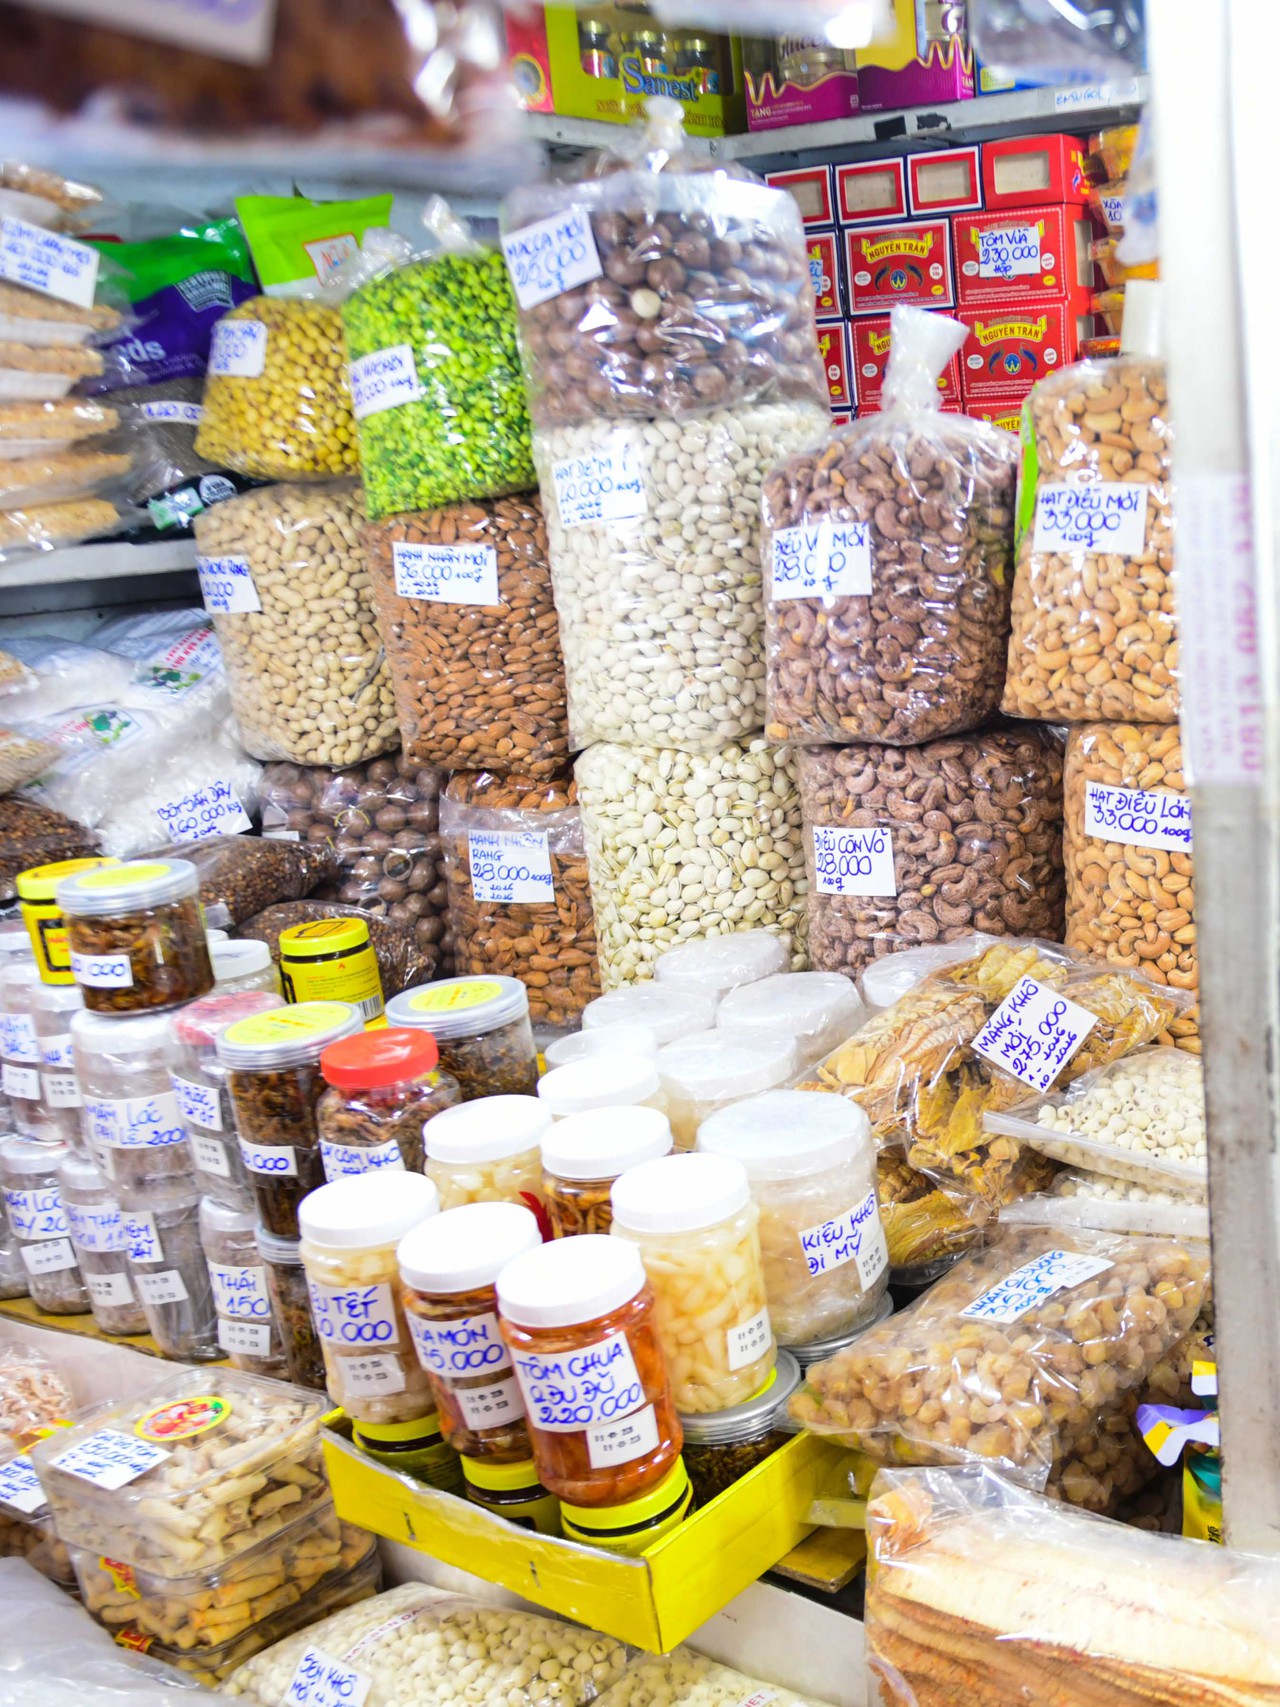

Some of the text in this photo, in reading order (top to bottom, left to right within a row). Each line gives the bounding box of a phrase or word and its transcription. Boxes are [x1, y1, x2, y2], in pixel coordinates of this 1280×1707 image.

[623, 56, 697, 101] Sanest
[979, 232, 1003, 247] TÔM
[981, 245, 1038, 265] 230.000
[1093, 801, 1192, 843] 33.000 100g
[472, 862, 530, 881] 28.000
[816, 852, 872, 876] 28.000
[1008, 979, 1039, 1013] KHÔ
[1012, 1000, 1067, 1076] 275.000
[147, 1128, 185, 1145] 200
[227, 1298, 269, 1316] 150
[332, 1286, 378, 1318] TẾT
[516, 1343, 625, 1380] TÔM CHUA
[539, 1383, 641, 1424] 220.000
